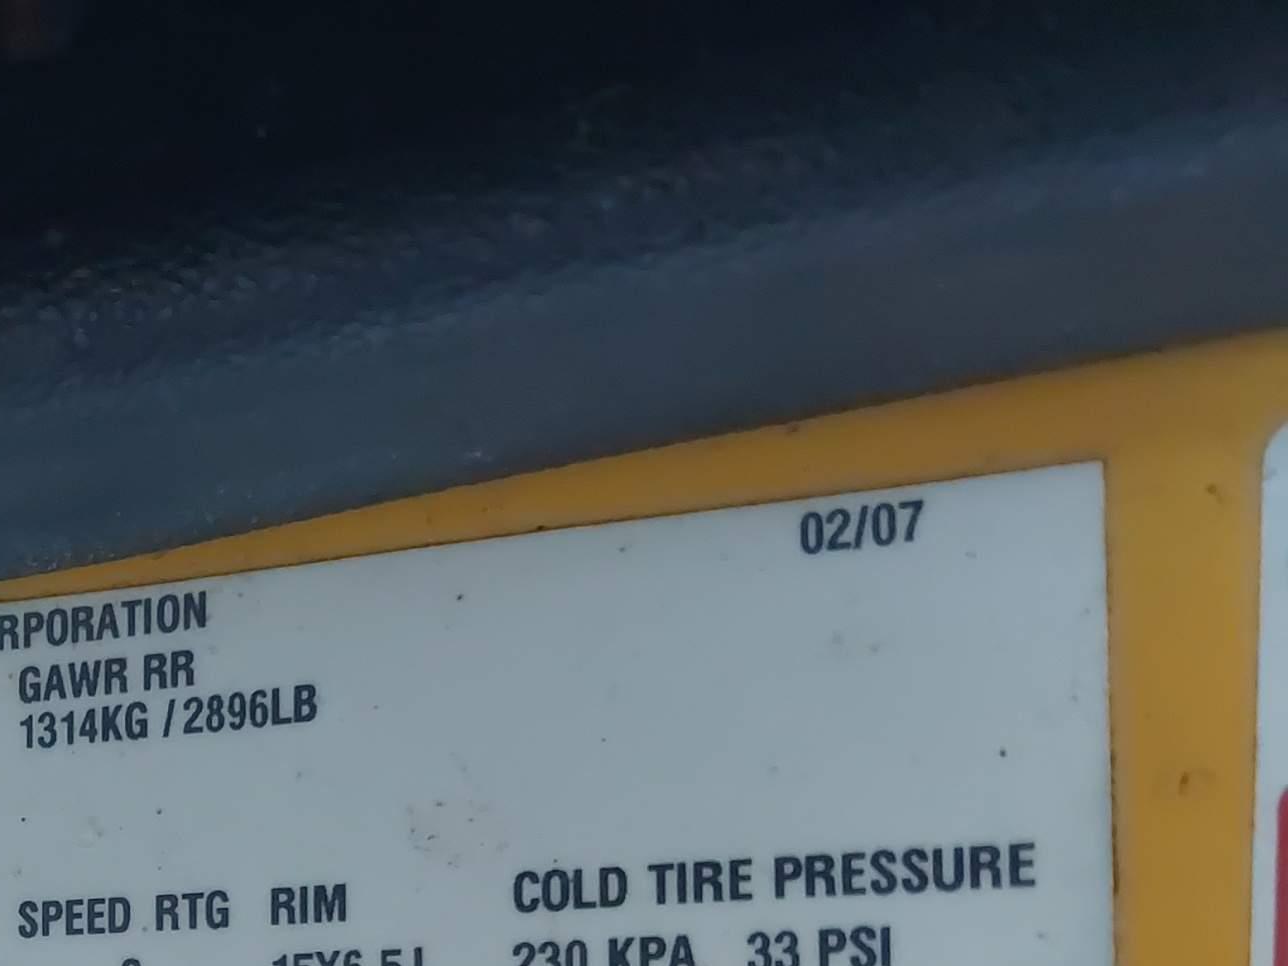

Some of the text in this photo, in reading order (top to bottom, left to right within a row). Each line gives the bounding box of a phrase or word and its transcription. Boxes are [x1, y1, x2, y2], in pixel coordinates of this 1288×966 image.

[801, 500, 923, 554] 02/07
[19, 650, 194, 704] GAWR RR
[20, 684, 317, 748] 1314KG / 2896LB
[514, 843, 1035, 913] COLD TIRE PRESSURE
[18, 897, 130, 938] SPEED
[156, 890, 229, 931] RTG
[271, 883, 346, 925] RIM
